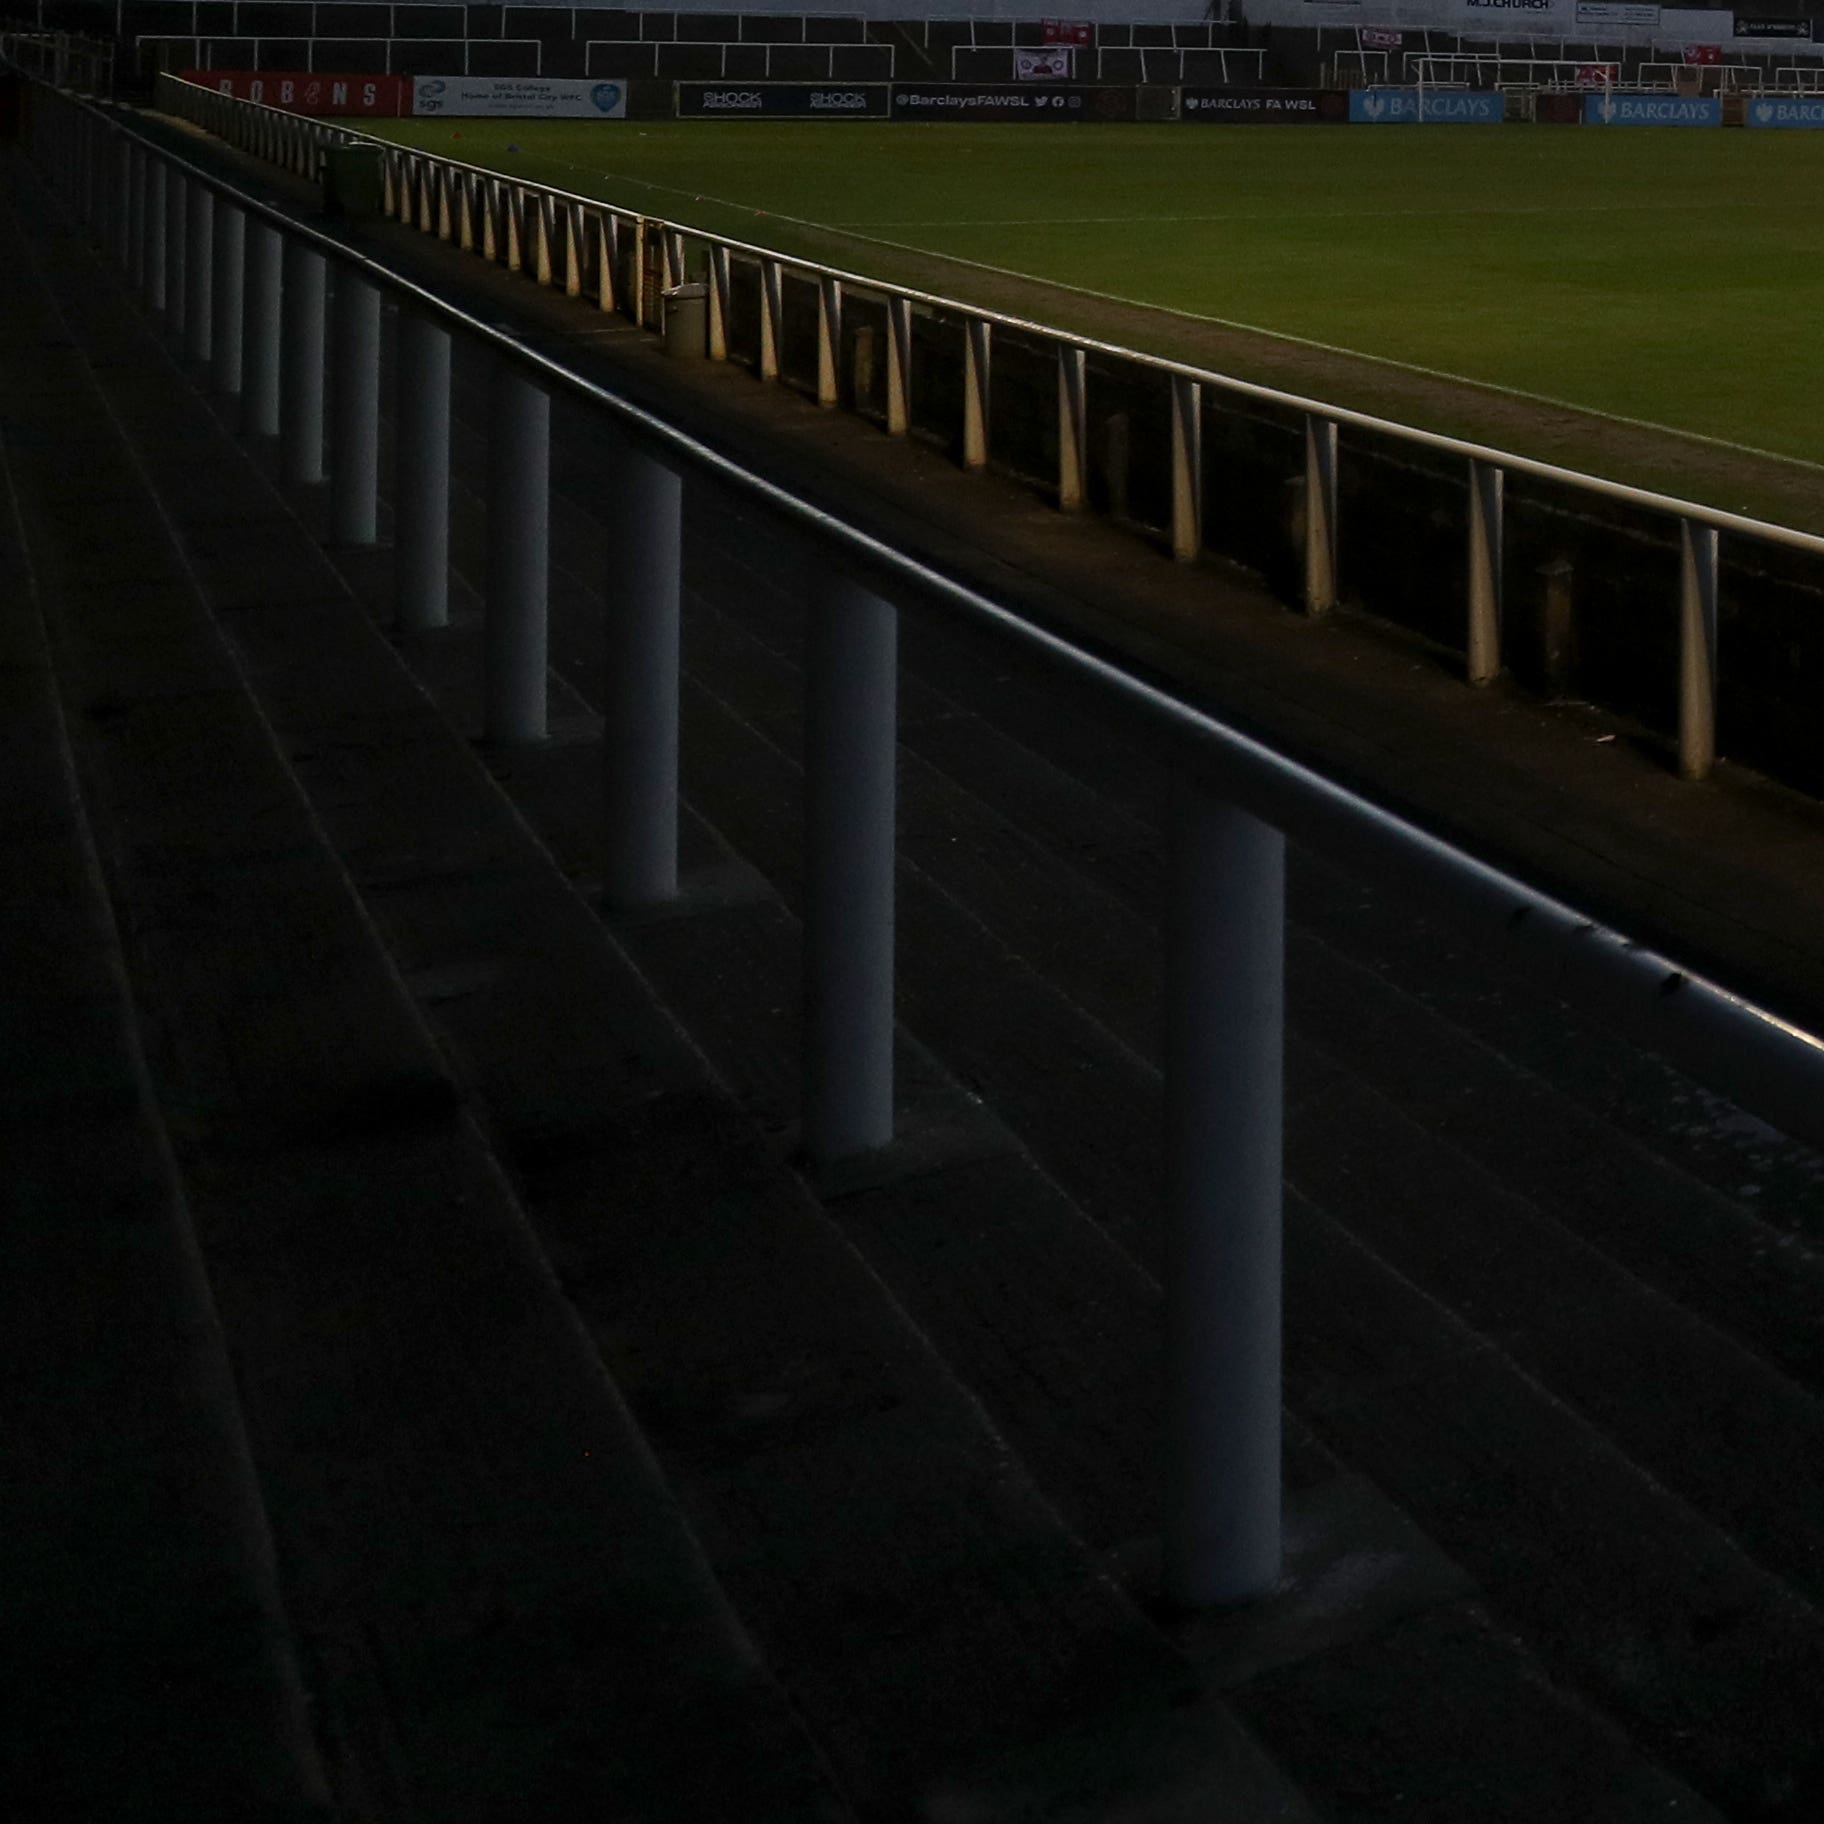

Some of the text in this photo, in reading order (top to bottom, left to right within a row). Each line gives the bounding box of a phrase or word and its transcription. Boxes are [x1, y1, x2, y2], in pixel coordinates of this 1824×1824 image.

[493, 83, 552, 93] SGS College
[461, 92, 490, 101] Home
[504, 92, 537, 101] Bristol
[538, 93, 557, 103] City
[561, 94, 583, 102] WFC
[703, 91, 763, 103] SHOCK
[810, 92, 867, 103] SHOCK
[895, 93, 1030, 111] @BarclaysFAWSL
[419, 99, 444, 112] sgs
[1200, 97, 1318, 112] BARCLAYS FA WSL
[1390, 97, 1491, 117] BARCLAYS
[1620, 101, 1711, 121] BARCLAYS
